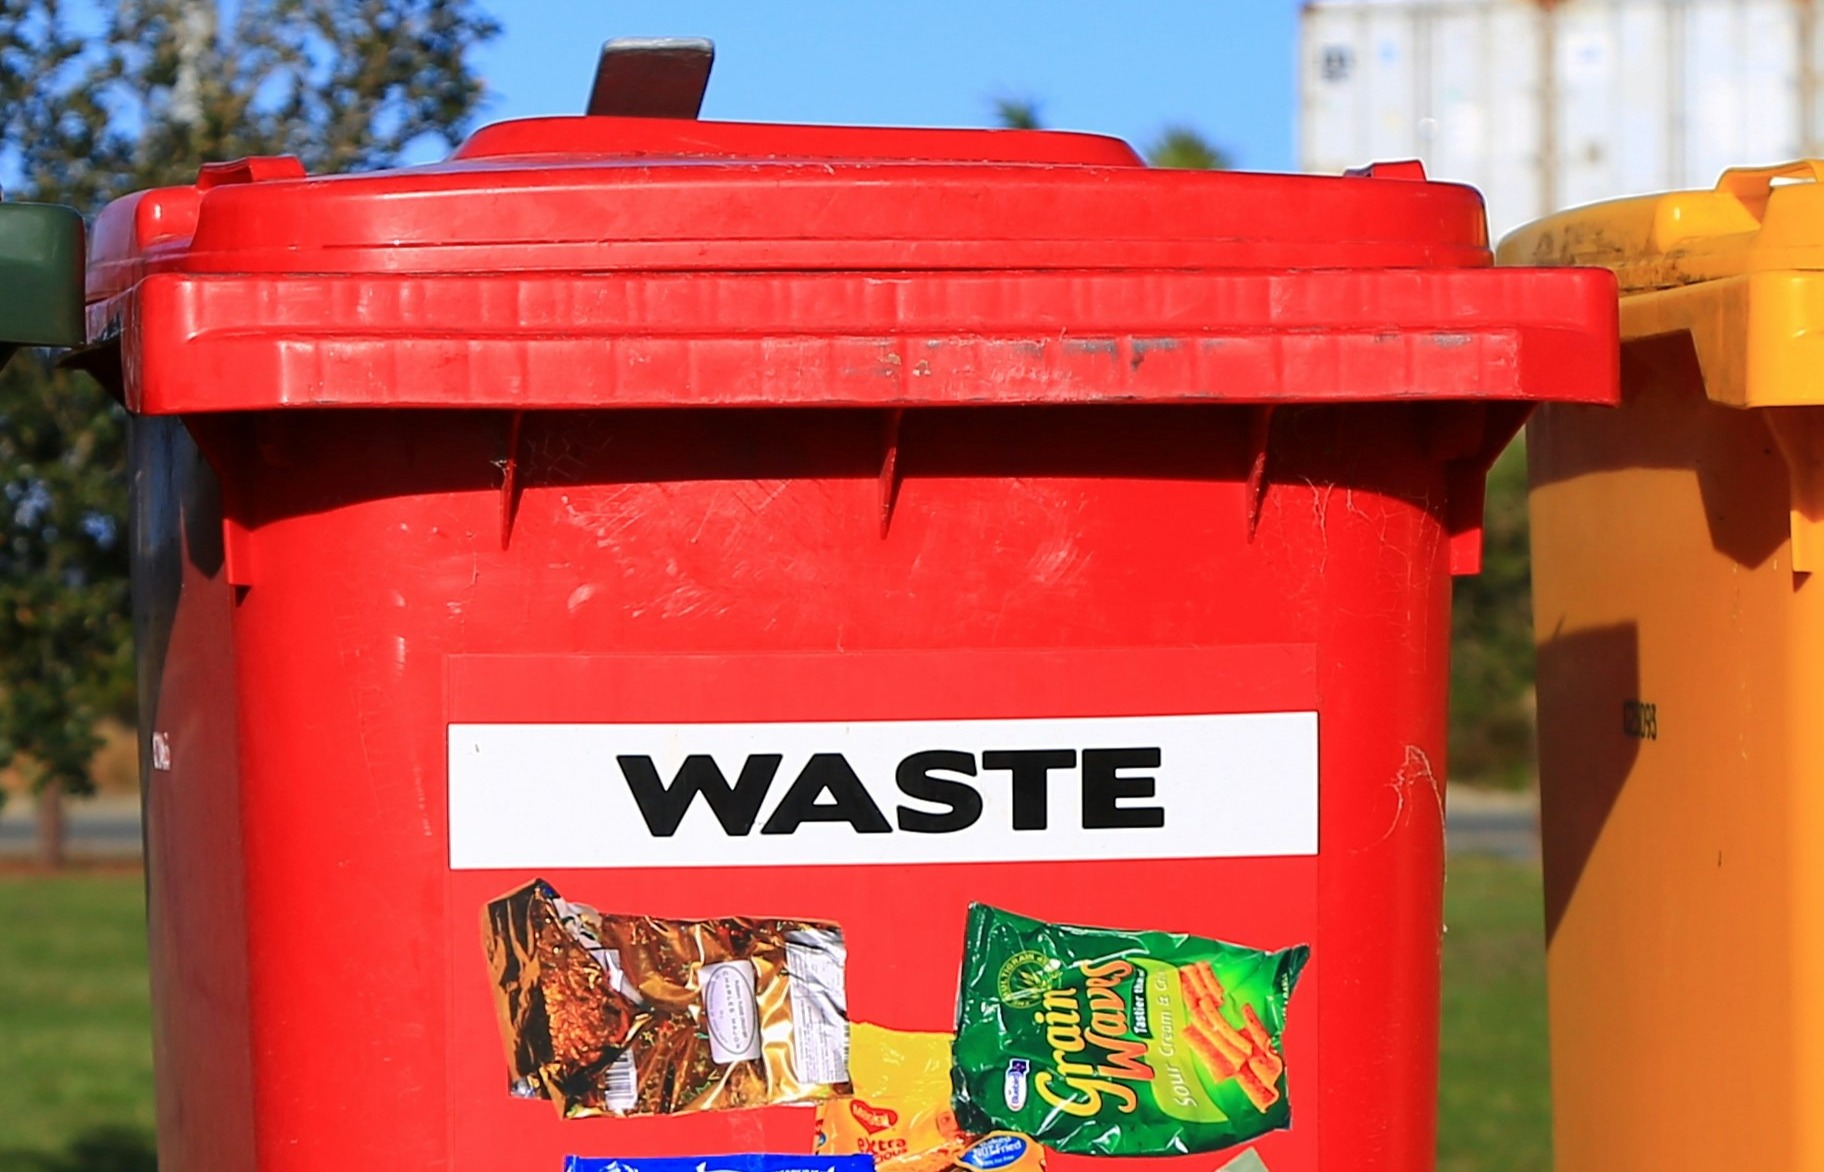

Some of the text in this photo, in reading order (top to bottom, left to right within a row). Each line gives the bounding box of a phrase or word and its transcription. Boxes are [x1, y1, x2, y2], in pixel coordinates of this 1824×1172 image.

[616, 745, 1166, 838] WASTE
[1079, 960, 1155, 1080] Waves
[1133, 995, 1149, 1035] Tastier
[1159, 1009, 1175, 1057] Cream
[1034, 986, 1137, 1117] Grain
[1173, 1063, 1199, 1109] Sour
